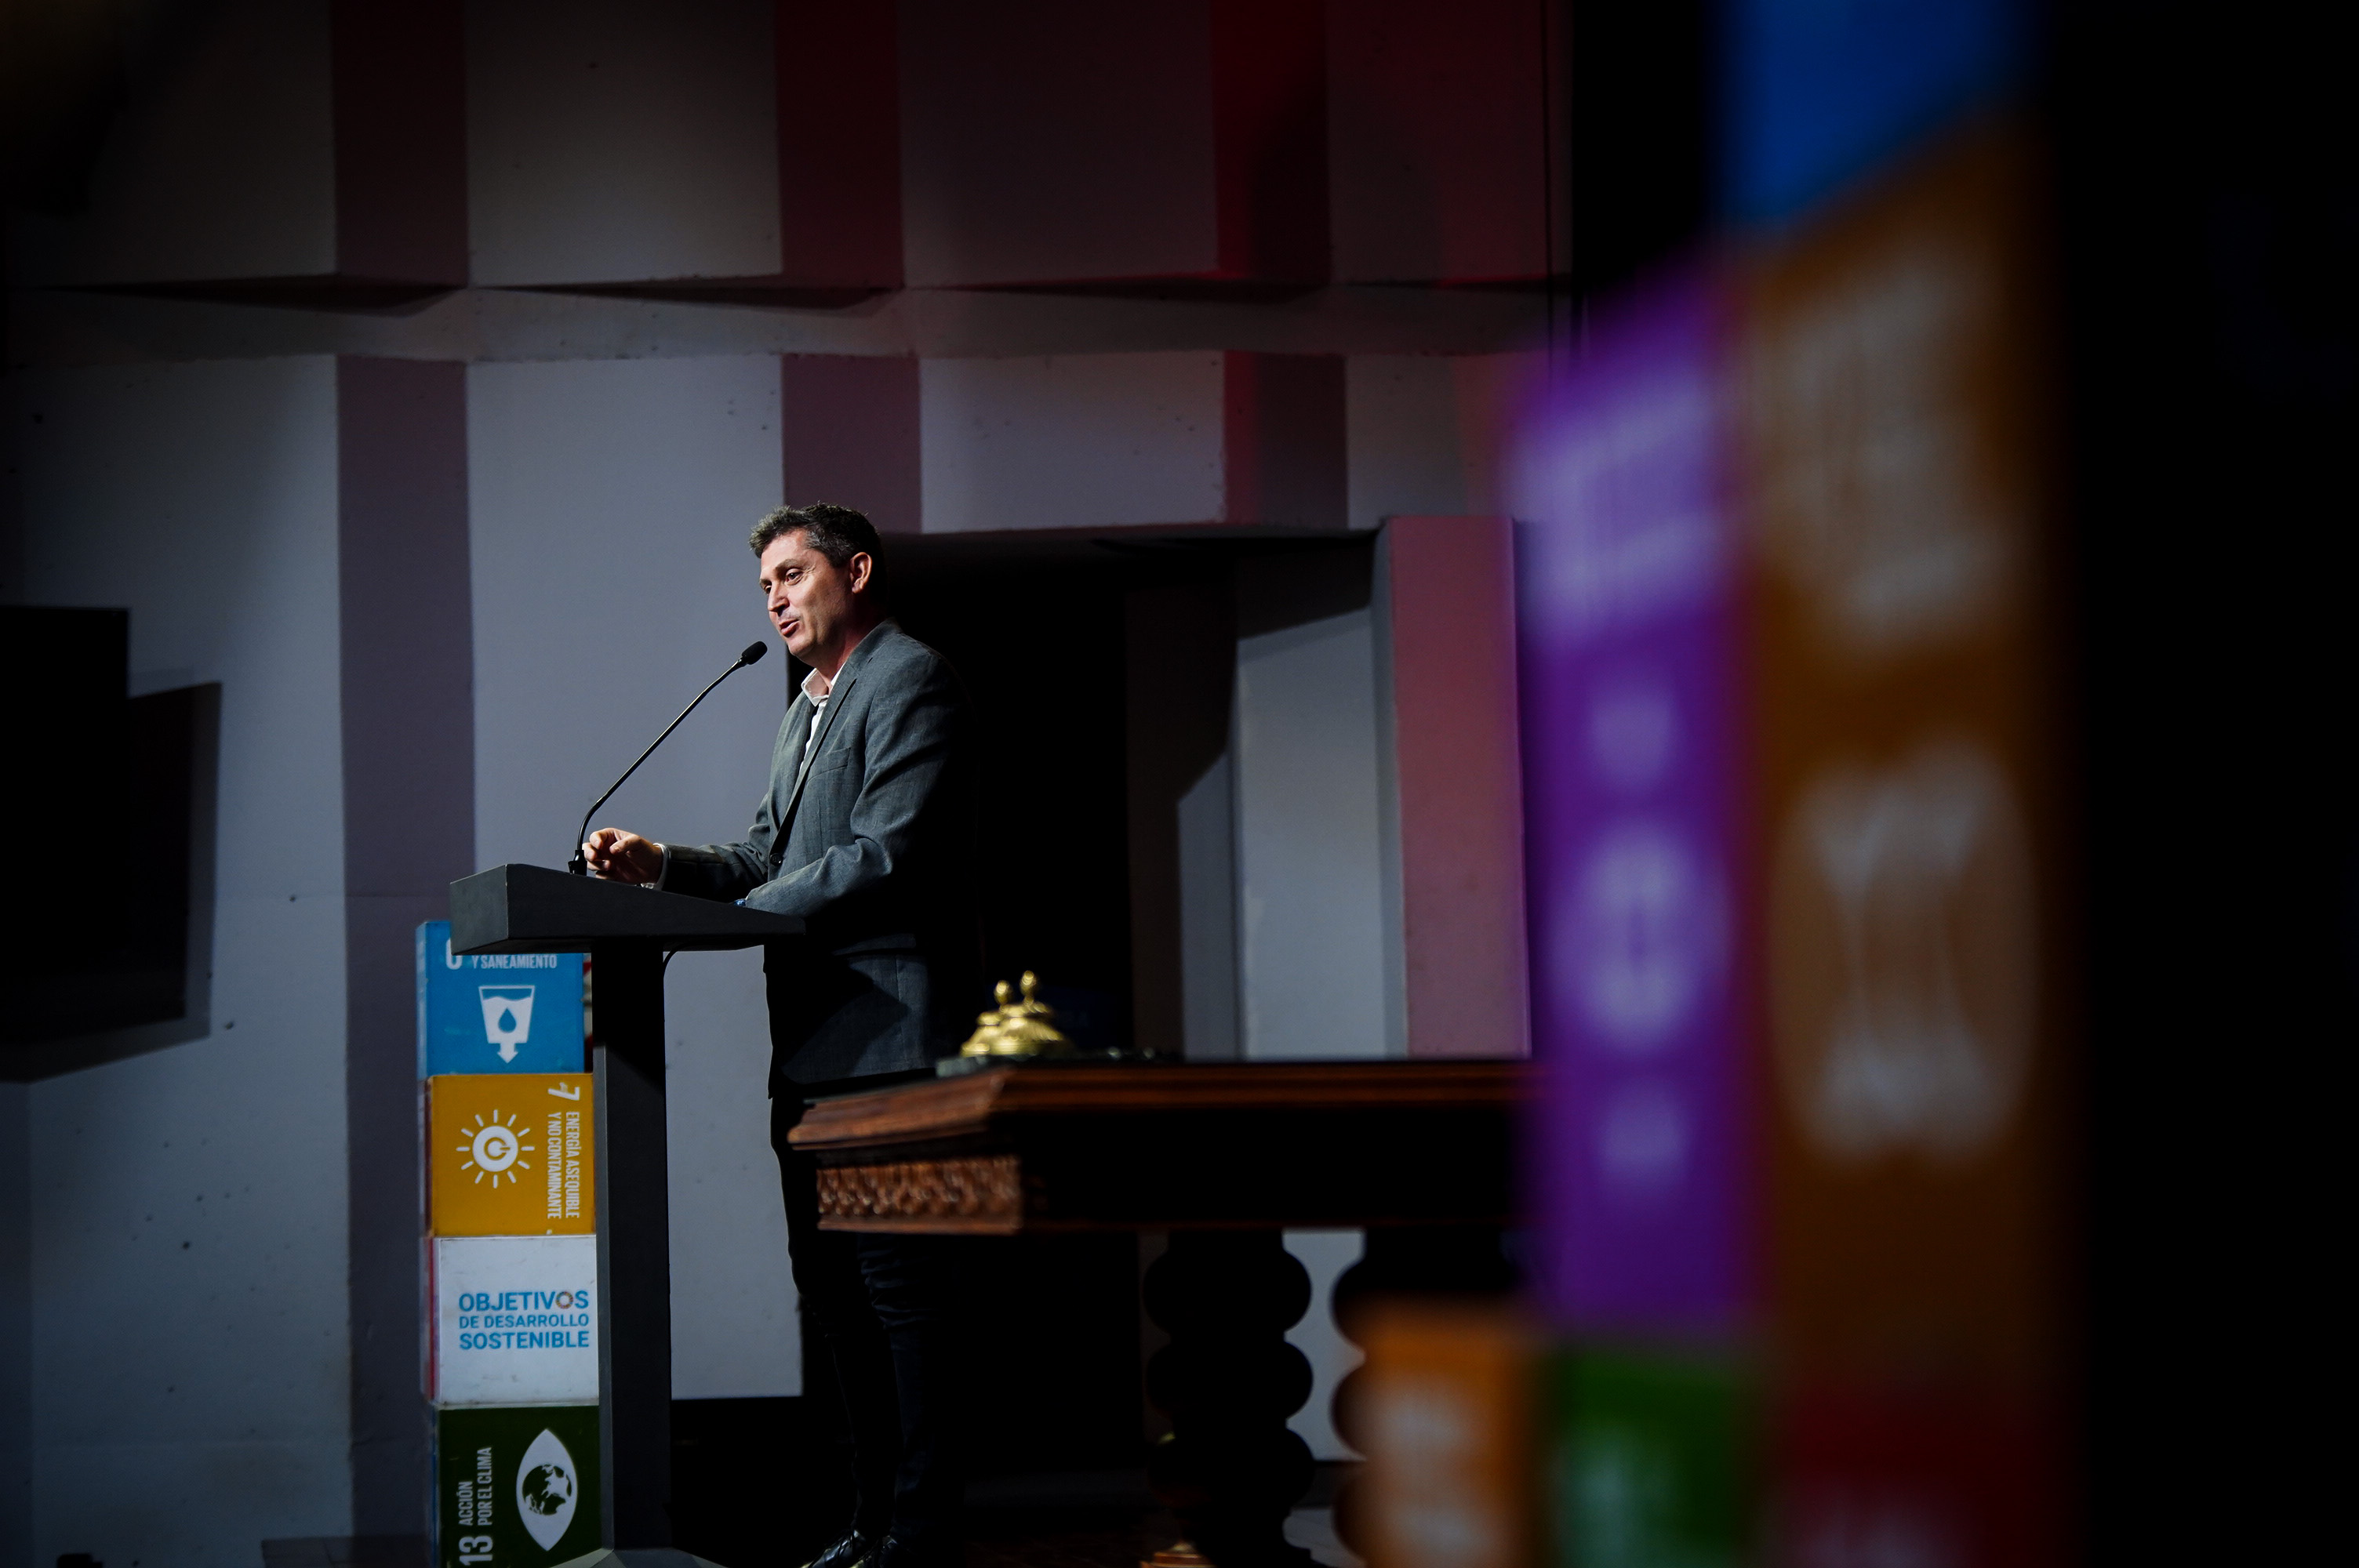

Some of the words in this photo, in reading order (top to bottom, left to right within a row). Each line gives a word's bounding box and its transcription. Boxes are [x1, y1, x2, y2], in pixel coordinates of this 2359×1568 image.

[472, 955, 480, 969] Y
[481, 954, 558, 969] SANEAMIENTO
[548, 1084, 580, 1102] 7
[547, 1120, 562, 1136] NO
[565, 1112, 581, 1158] ENERGÍA
[547, 1137, 562, 1219] CONTAMINANTE
[565, 1160, 580, 1218] ASEQUIBLE
[459, 1290, 589, 1312] OBJETIVOS
[460, 1316, 479, 1329] DE
[484, 1313, 589, 1328] DESARROLLO
[460, 1330, 589, 1350] SOSTENIBLE
[477, 1446, 492, 1484] CLIMA
[456, 1481, 473, 1526] ACCIÓN
[477, 1486, 493, 1499] EL
[477, 1501, 493, 1526] POR
[459, 1535, 493, 1566] 13
